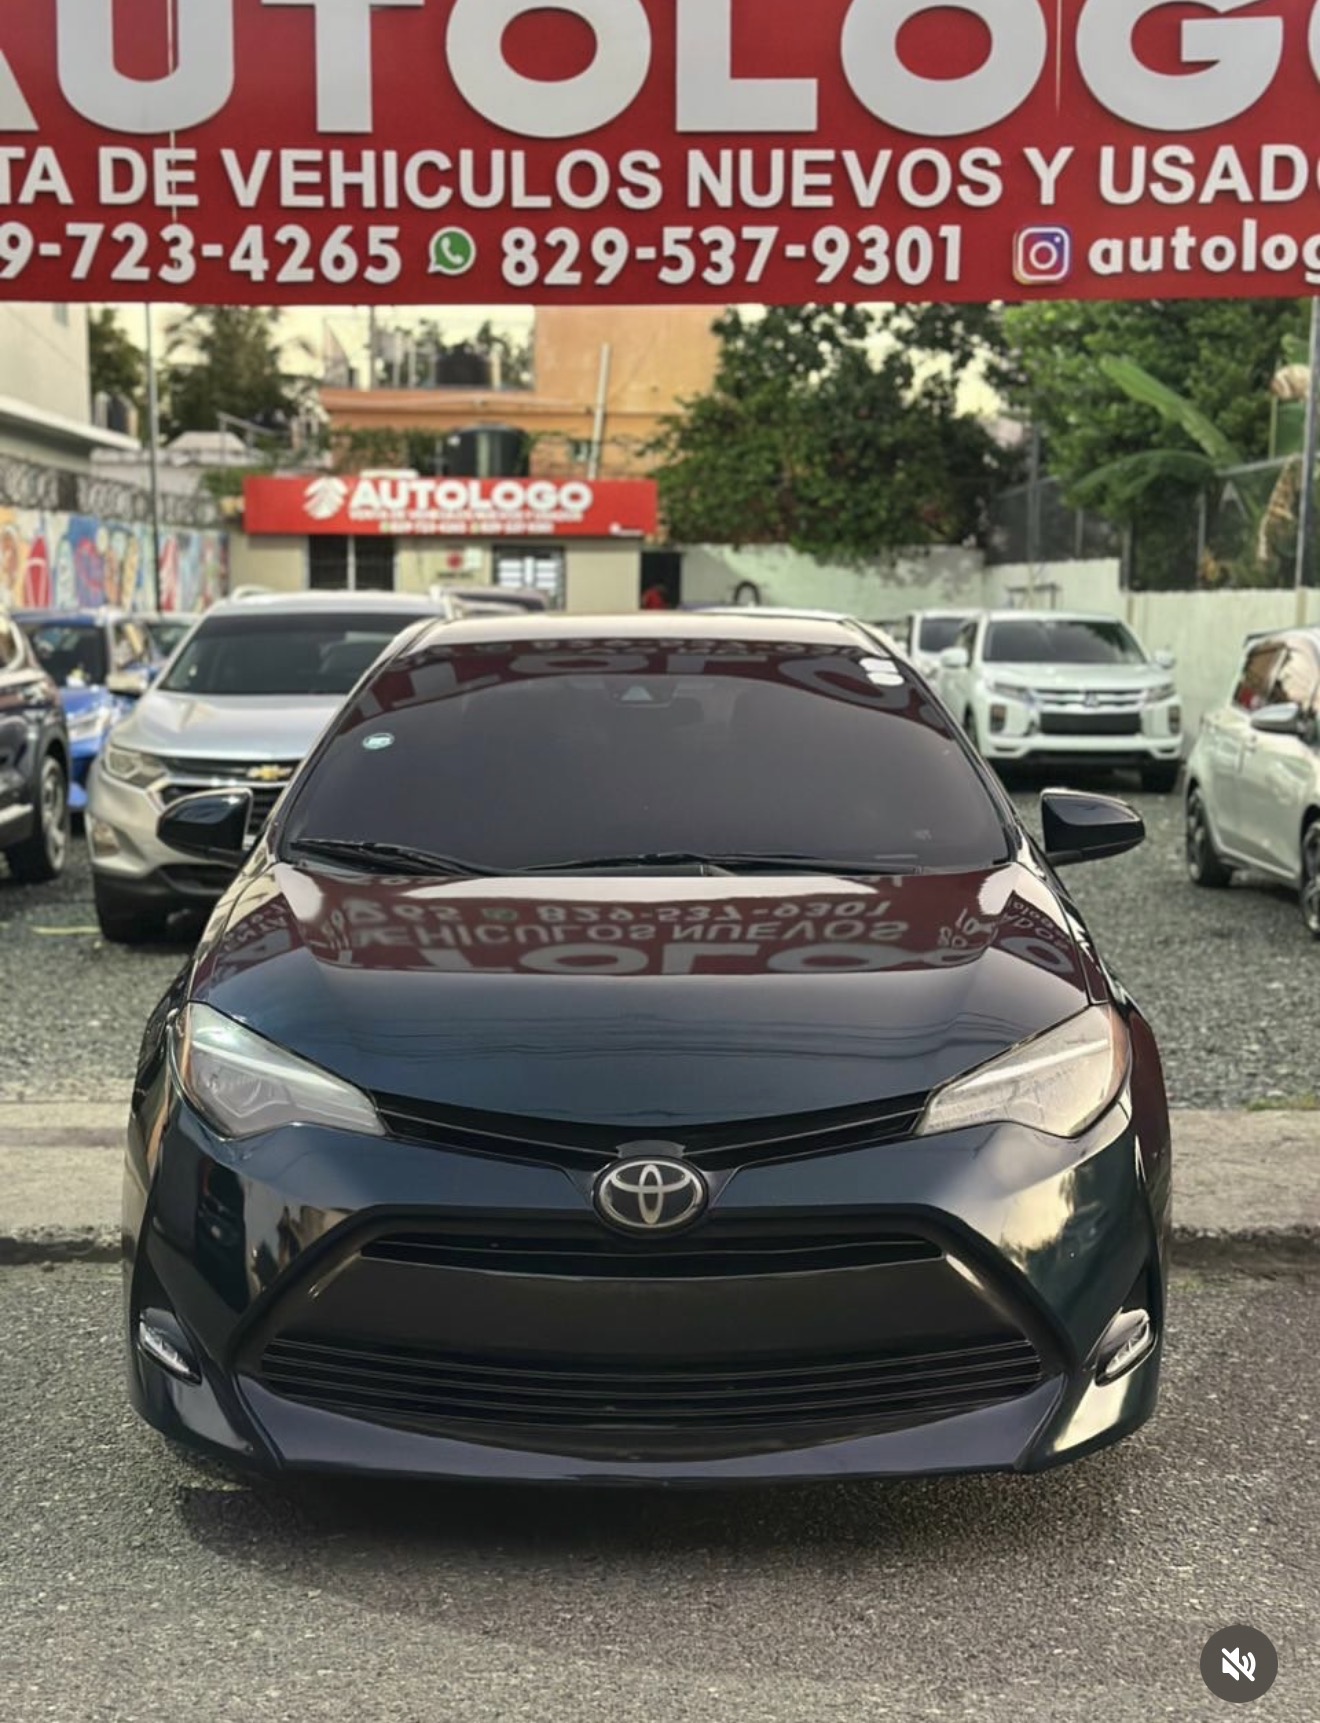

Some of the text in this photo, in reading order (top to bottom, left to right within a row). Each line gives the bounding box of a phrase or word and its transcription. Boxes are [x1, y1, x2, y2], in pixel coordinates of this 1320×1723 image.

[99, 146, 198, 207] DE
[221, 148, 663, 210] VEHICULOS
[688, 147, 1003, 209] NUEVOS
[1023, 146, 1075, 205] Y
[502, 225, 962, 286] 829-537-9301
[350, 480, 593, 512] AUTOLOGO
